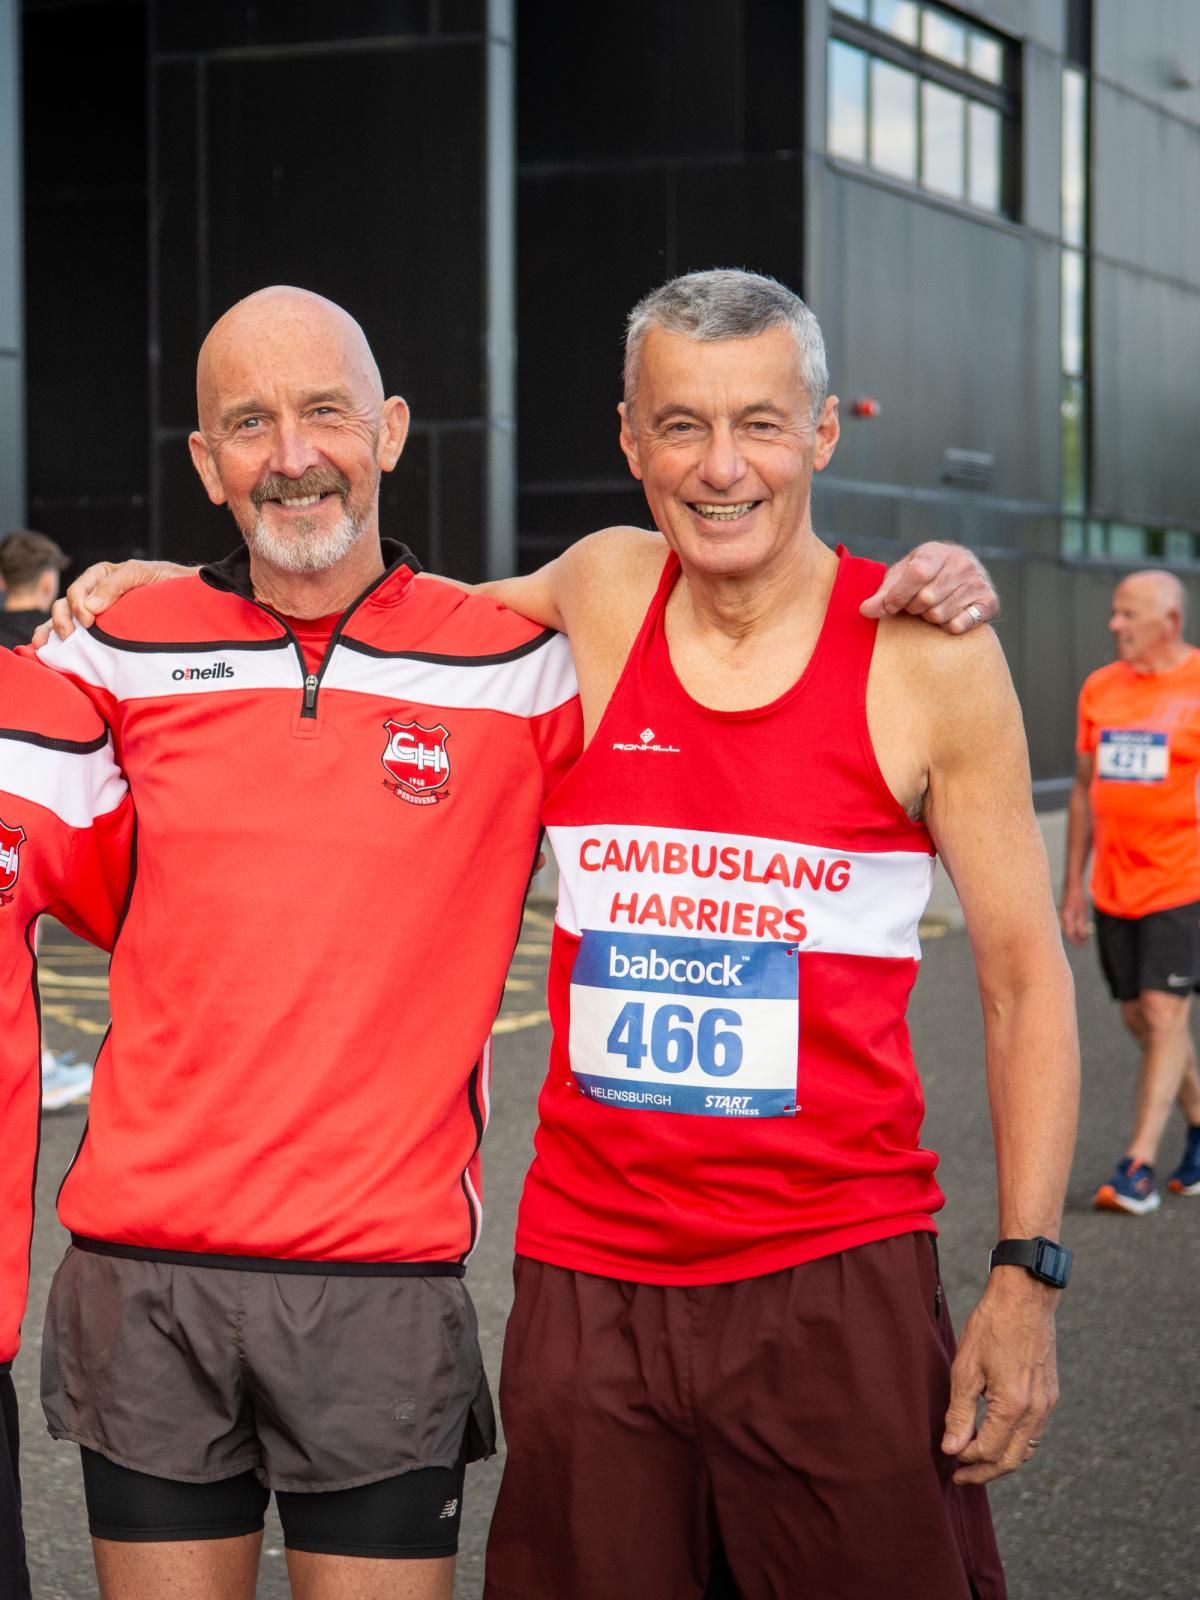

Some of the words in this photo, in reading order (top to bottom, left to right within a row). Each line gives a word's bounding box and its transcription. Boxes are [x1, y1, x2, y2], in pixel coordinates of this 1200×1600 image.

[391, 732, 441, 773] CH
[612, 743, 681, 753] RONHILL
[397, 789, 437, 804] PERSEVERE
[579, 838, 851, 892] CAMBUSLANG
[609, 892, 808, 943] HARRIERS
[609, 945, 744, 987] babcock
[606, 1001, 744, 1078] 466
[590, 1086, 672, 1106] HELENSBURGH
[704, 1095, 753, 1109] START
[725, 1108, 760, 1116] FITNESS
